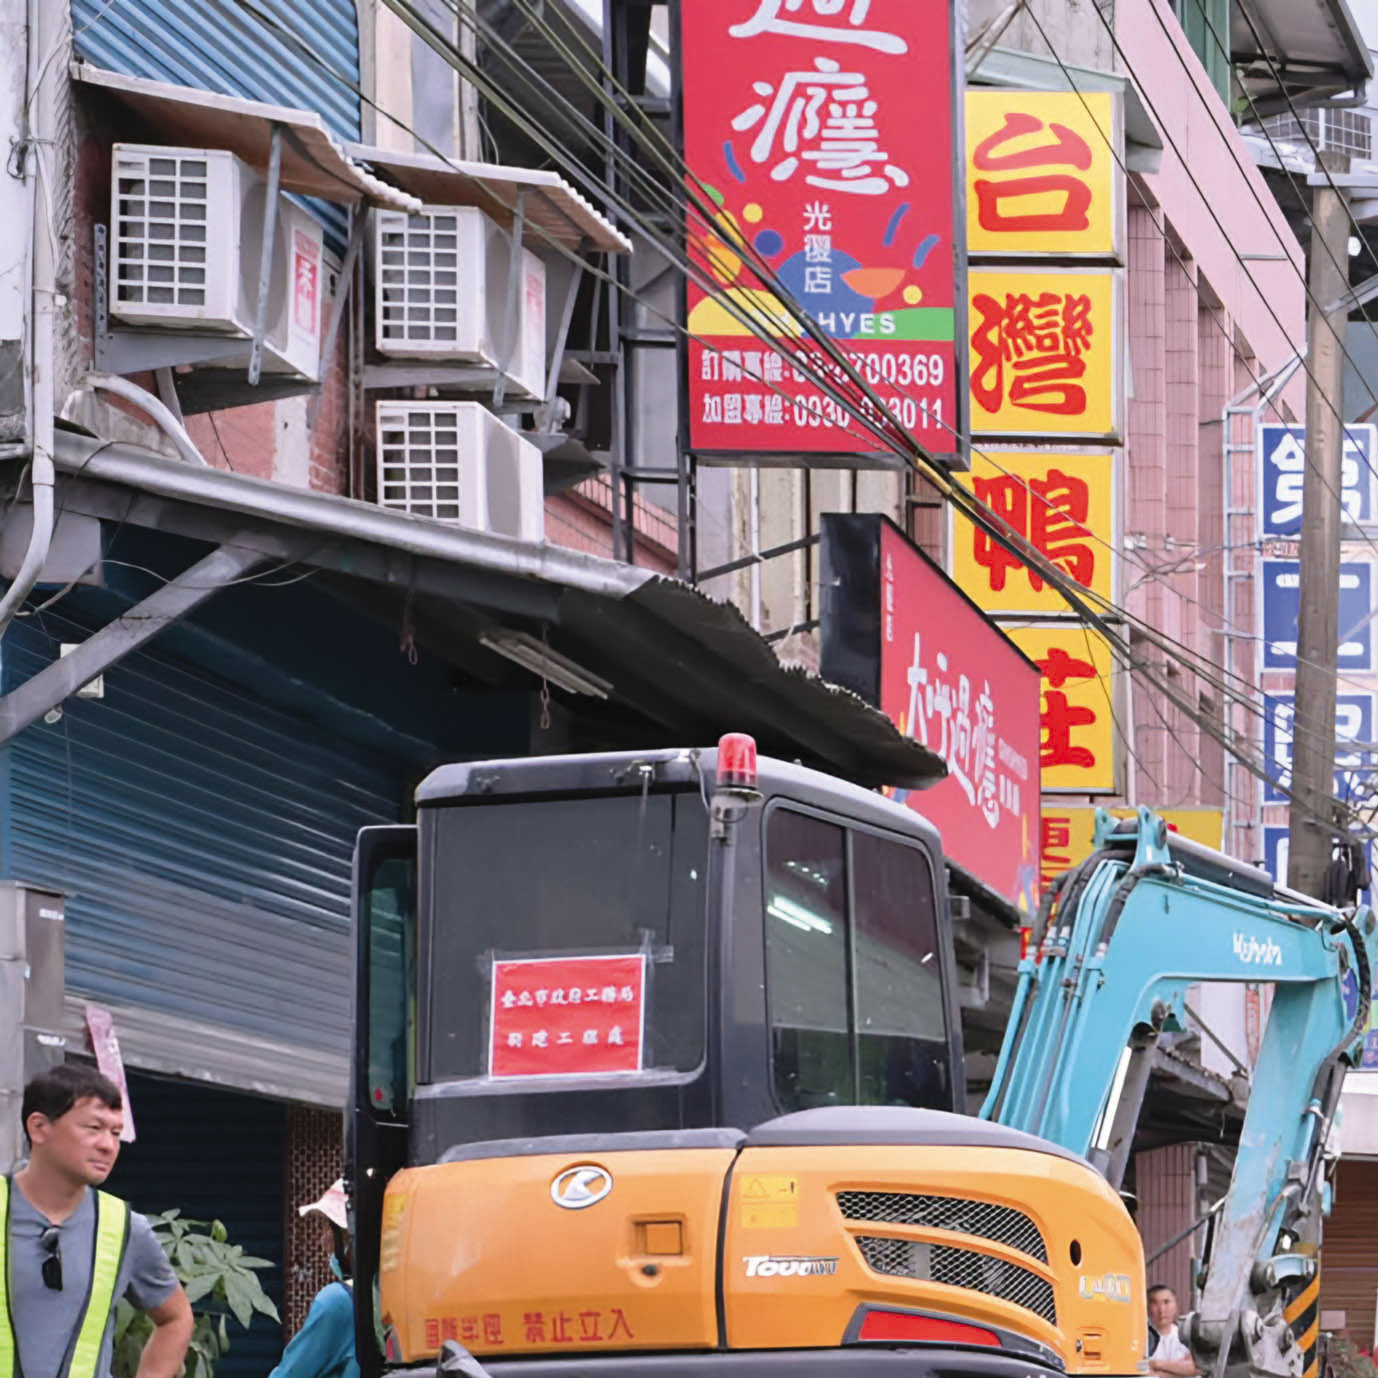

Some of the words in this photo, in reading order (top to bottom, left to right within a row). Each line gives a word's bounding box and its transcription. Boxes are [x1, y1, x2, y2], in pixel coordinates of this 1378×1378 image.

[802, 201, 832, 294] 光復店
[523, 1308, 635, 1344] 禁止立入
